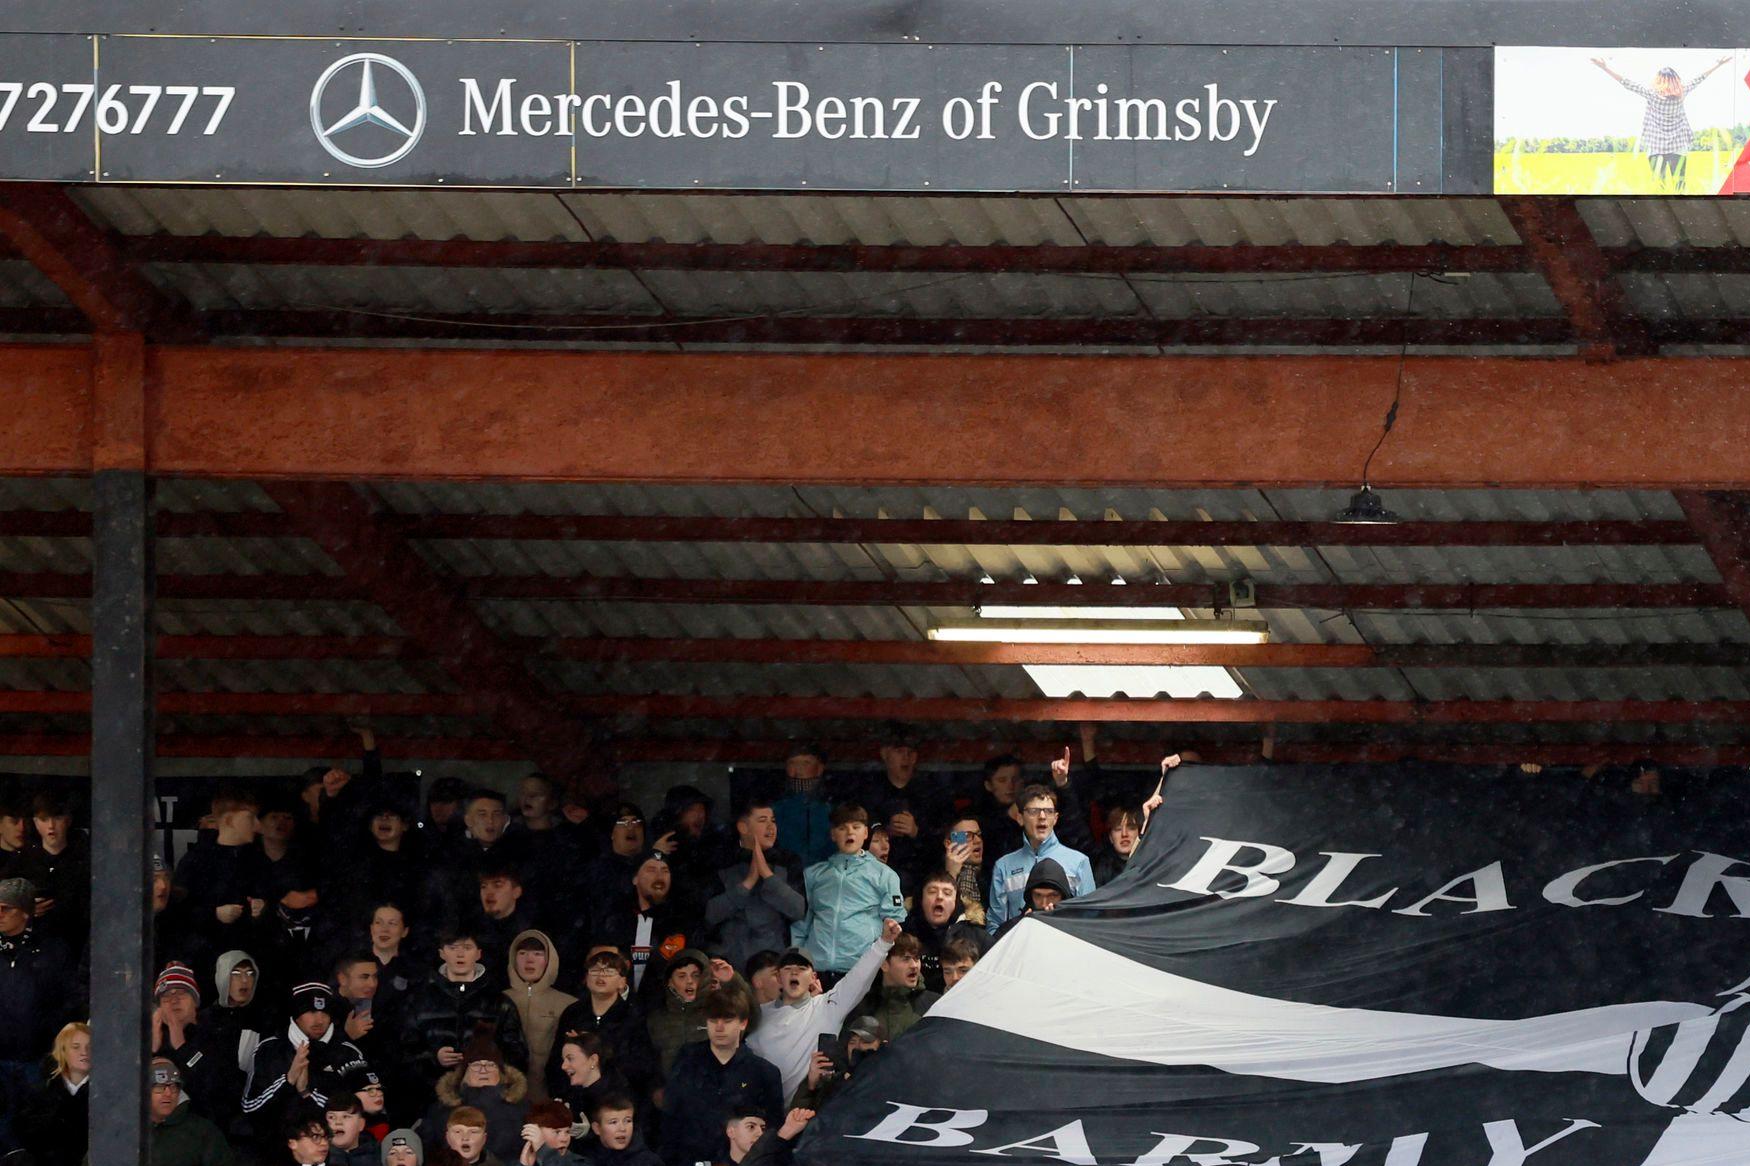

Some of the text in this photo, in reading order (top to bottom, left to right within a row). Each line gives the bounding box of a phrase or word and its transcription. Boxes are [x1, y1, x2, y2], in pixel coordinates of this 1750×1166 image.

[0, 82, 235, 135] 7276777
[459, 77, 1278, 156] Mercedes-Benz of Grimsby
